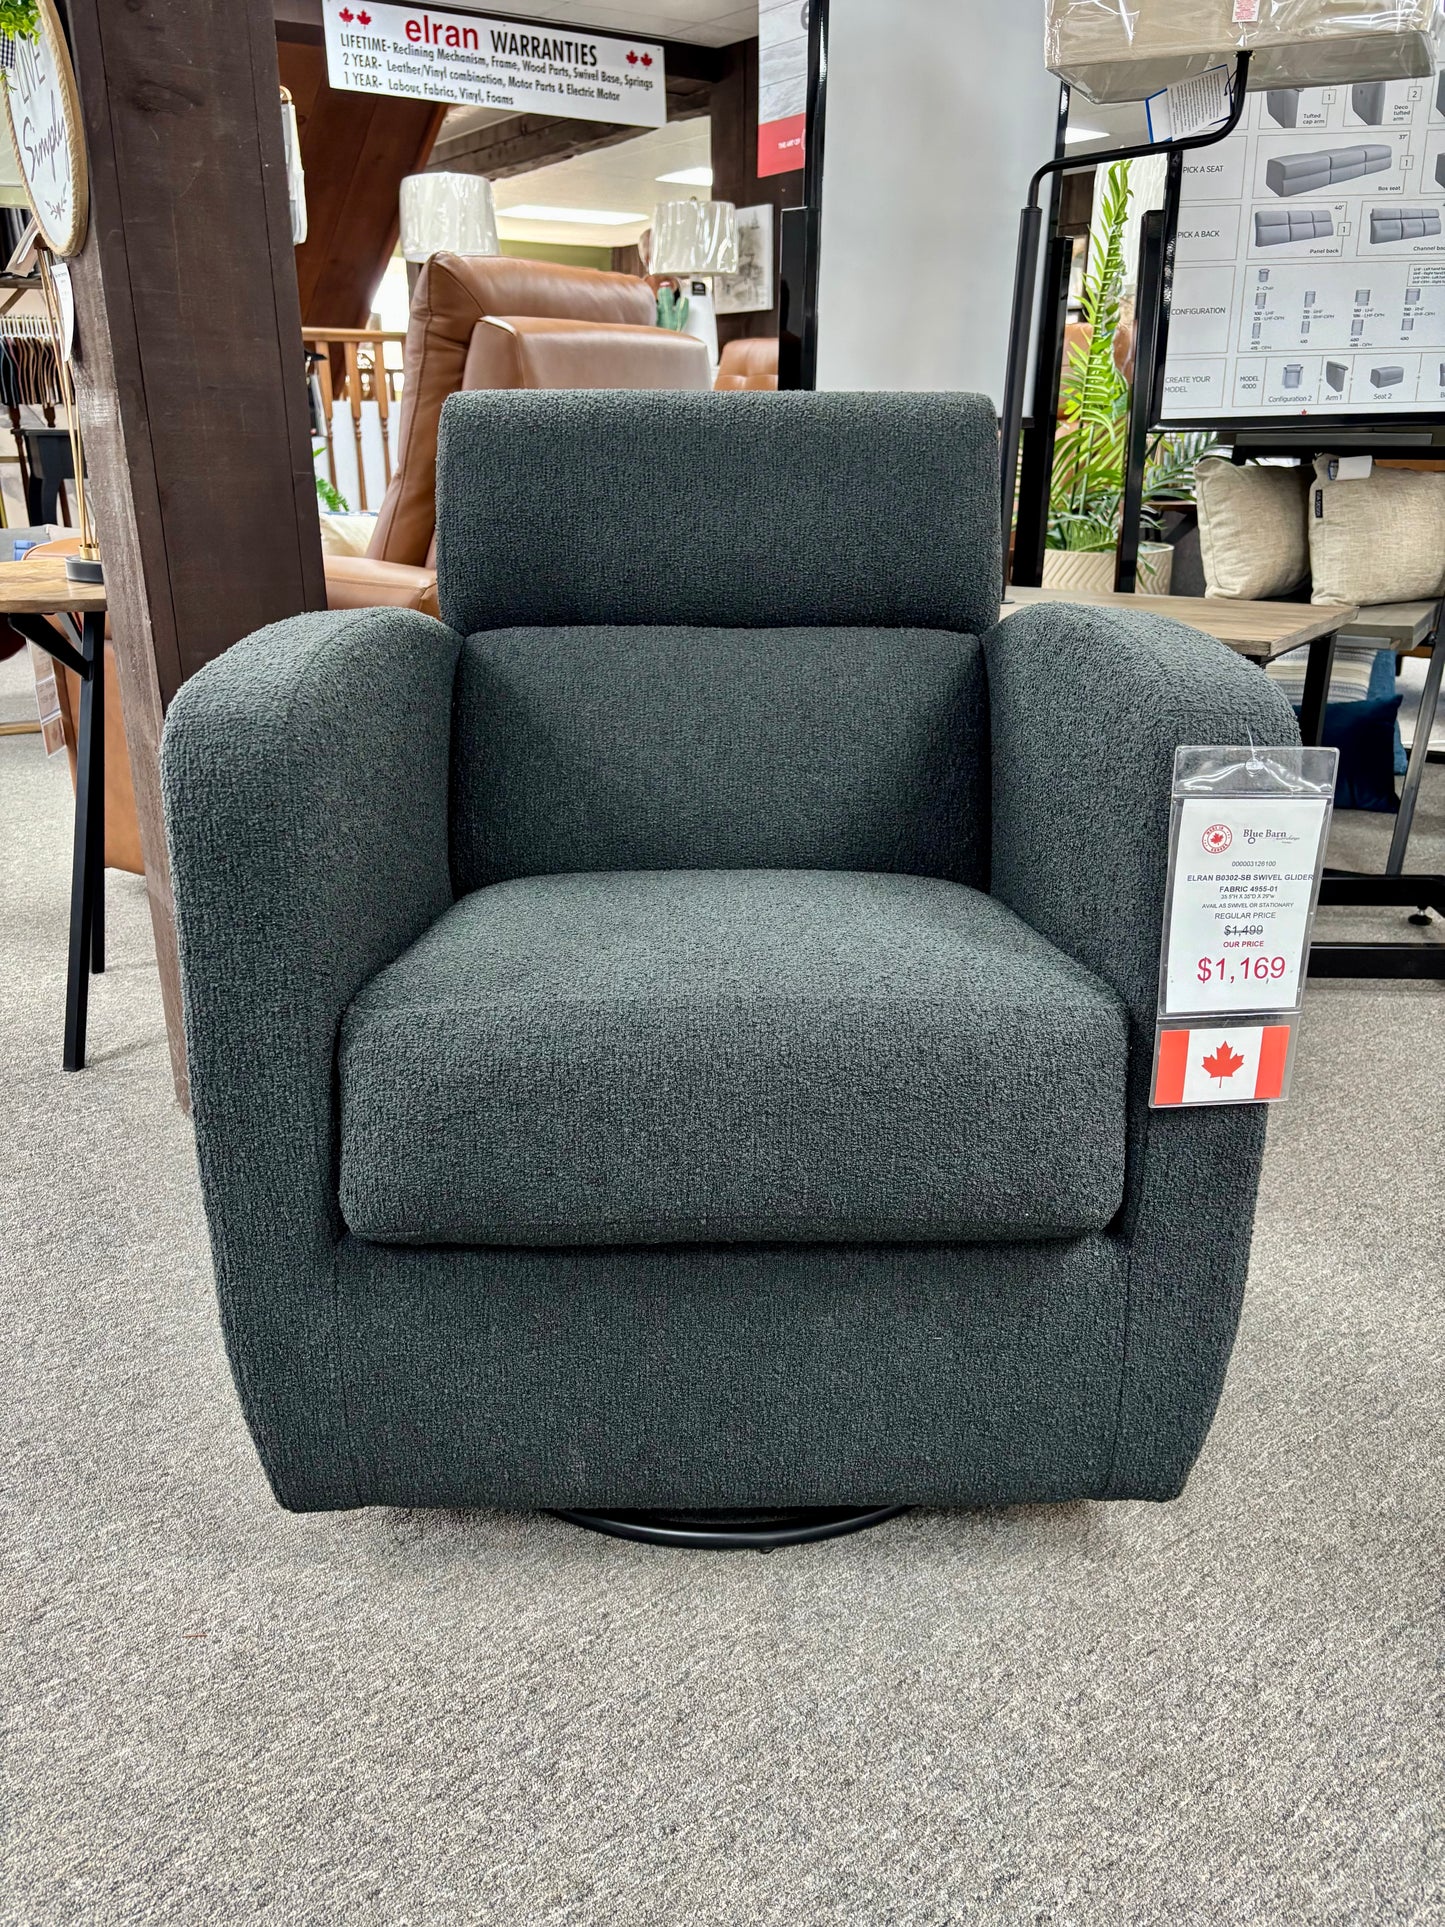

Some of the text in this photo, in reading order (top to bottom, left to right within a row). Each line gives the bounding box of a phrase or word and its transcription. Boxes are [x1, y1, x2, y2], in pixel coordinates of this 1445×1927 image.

[405, 15, 598, 67] elran WARRANTIES
[340, 33, 653, 91] LIFETIME- Reclining Mechanism, Frame, Wood Parts, Swivel Base, Springs
[342, 52, 620, 101] 2 YEAR- Leather/Vinyl combination, Motor Parts & Electric Motor
[344, 71, 514, 105] 1 YEAR- Labour, Fabrics, Vinyl, Foams
[22, 89, 71, 183] Simply
[1207, 165, 1224, 173] SEAT
[1201, 230, 1220, 238] BACK
[1170, 307, 1226, 316] CONFIGURATION
[1165, 375, 1210, 384] CREATE YOUR
[1243, 829, 1264, 840] Blue
[1265, 829, 1287, 838] Barn
[1284, 873, 1313, 881] GLIDER
[1250, 885, 1278, 893] 4955-01
[1224, 925, 1263, 937] $1,499
[1241, 940, 1264, 948] PRICE
[1197, 956, 1286, 984] $1,169
